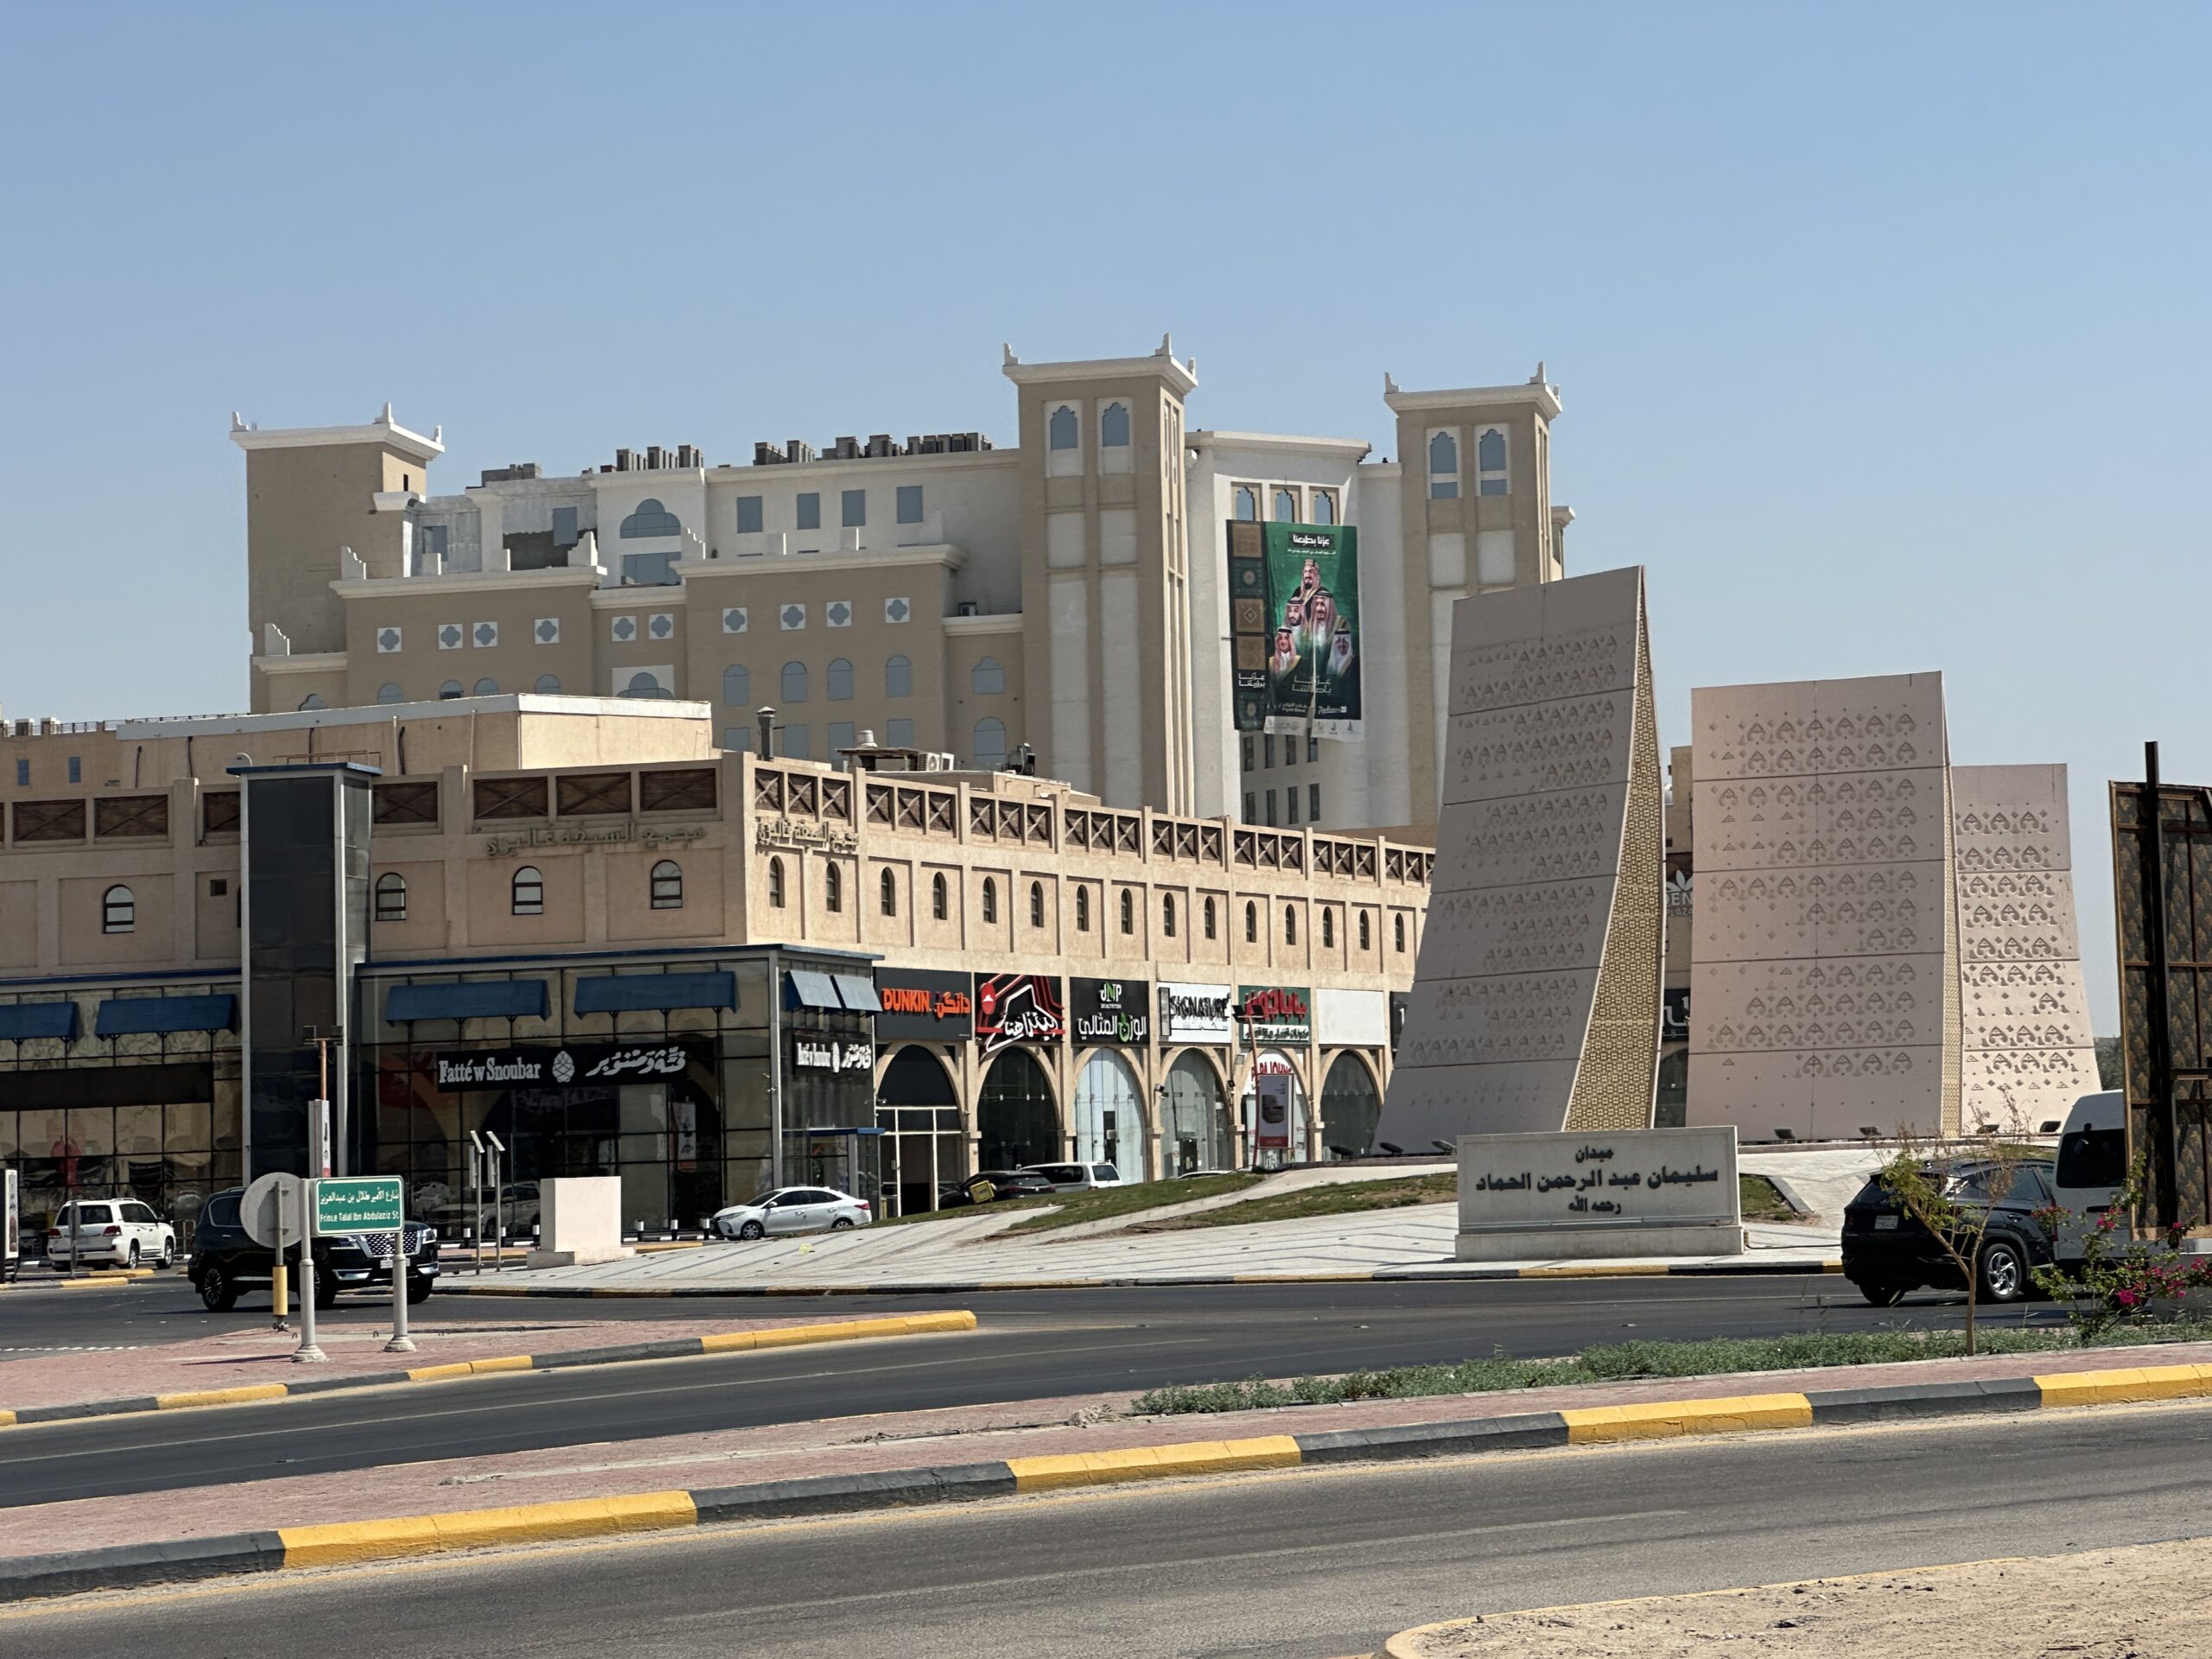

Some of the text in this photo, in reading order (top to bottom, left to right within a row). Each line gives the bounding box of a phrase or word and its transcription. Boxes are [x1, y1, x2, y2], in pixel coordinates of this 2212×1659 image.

[439, 1057, 542, 1084] Fatté w Snoubar
[1575, 1146, 1613, 1163] ميدان
[1476, 1166, 1719, 1192] سليمان عبد الرحمن الحماد
[347, 1192, 355, 1204] بن
[356, 1190, 370, 1203] طلال
[385, 1189, 399, 1202] شارع
[1568, 1195, 1588, 1214] الله
[320, 1213, 337, 1223] Prince
[339, 1212, 352, 1222] Talal
[353, 1211, 362, 1221] Ibn
[363, 1211, 391, 1221] Abdulaziz
